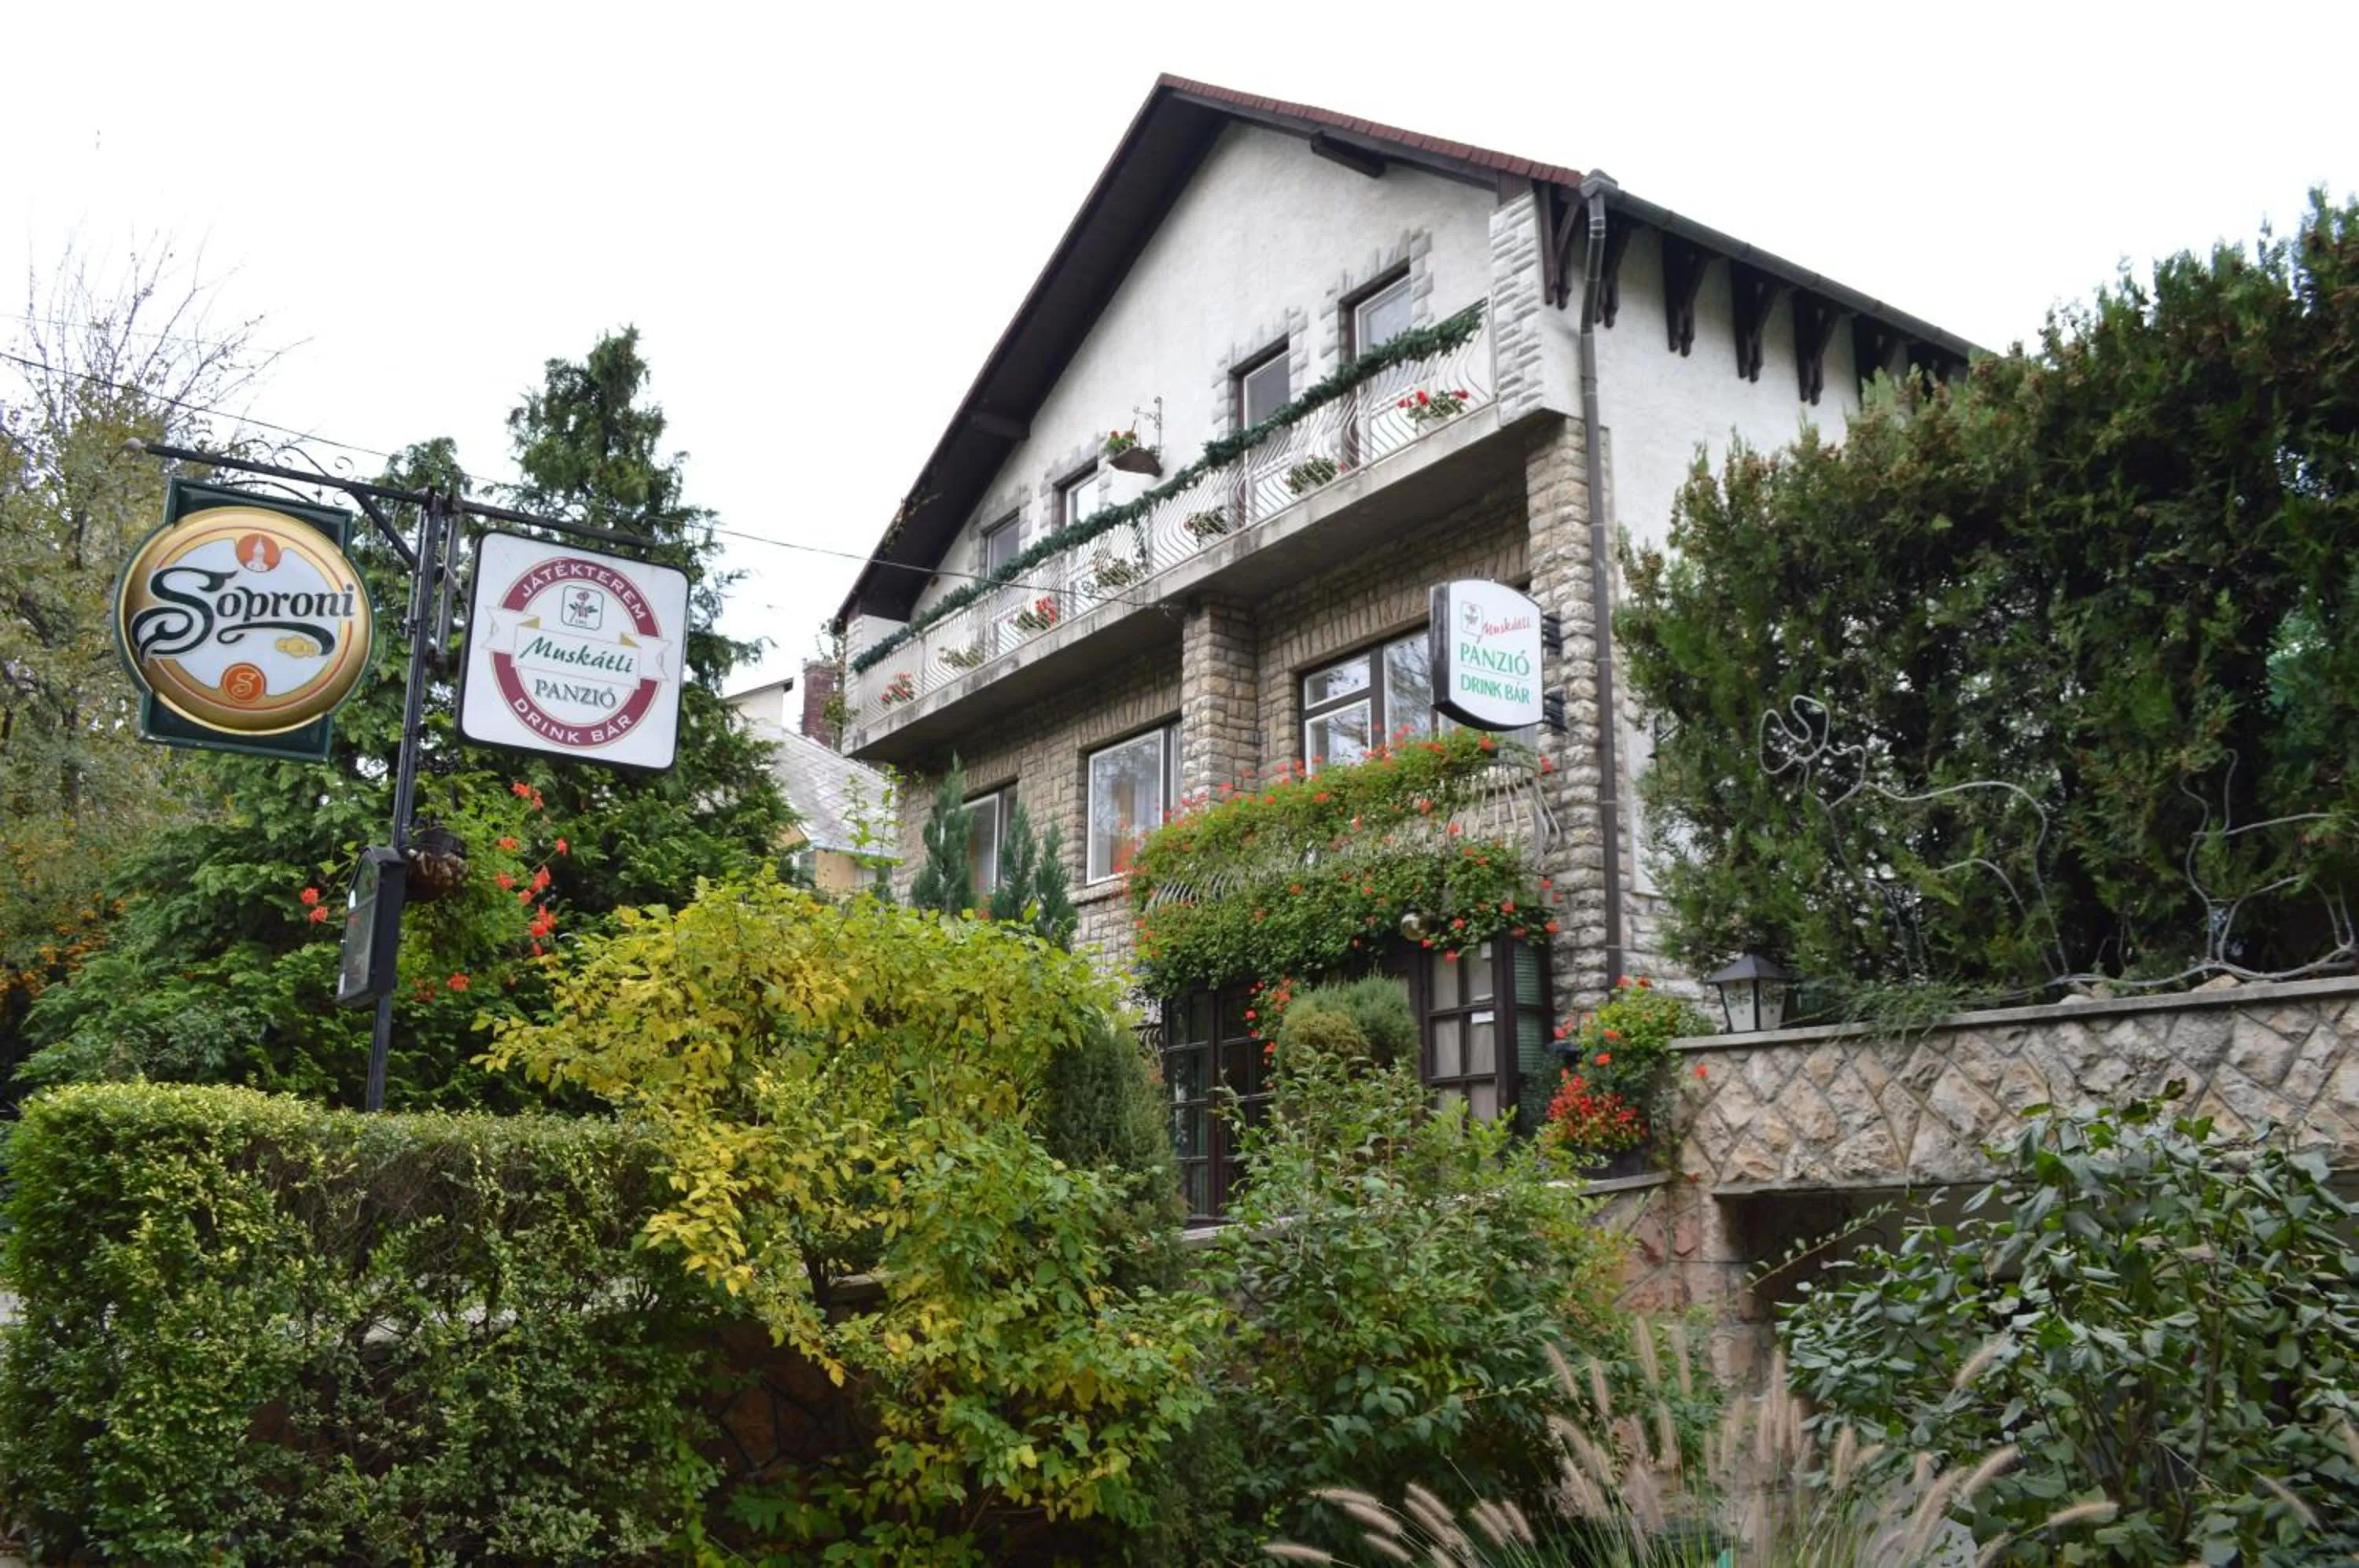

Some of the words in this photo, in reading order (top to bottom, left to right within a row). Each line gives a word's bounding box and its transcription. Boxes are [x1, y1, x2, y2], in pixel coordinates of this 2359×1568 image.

[522, 562, 646, 620] JÁTÉKTEREM
[131, 567, 355, 664] Soproni
[518, 636, 634, 673] Muskátli
[1460, 641, 1530, 676] PANZIÓ
[534, 679, 616, 710] PANZIÓ
[1460, 674, 1502, 699] DRINK
[1504, 681, 1530, 705] BÁR
[513, 698, 580, 743] DRINK
[591, 714, 632, 742] BÁR
